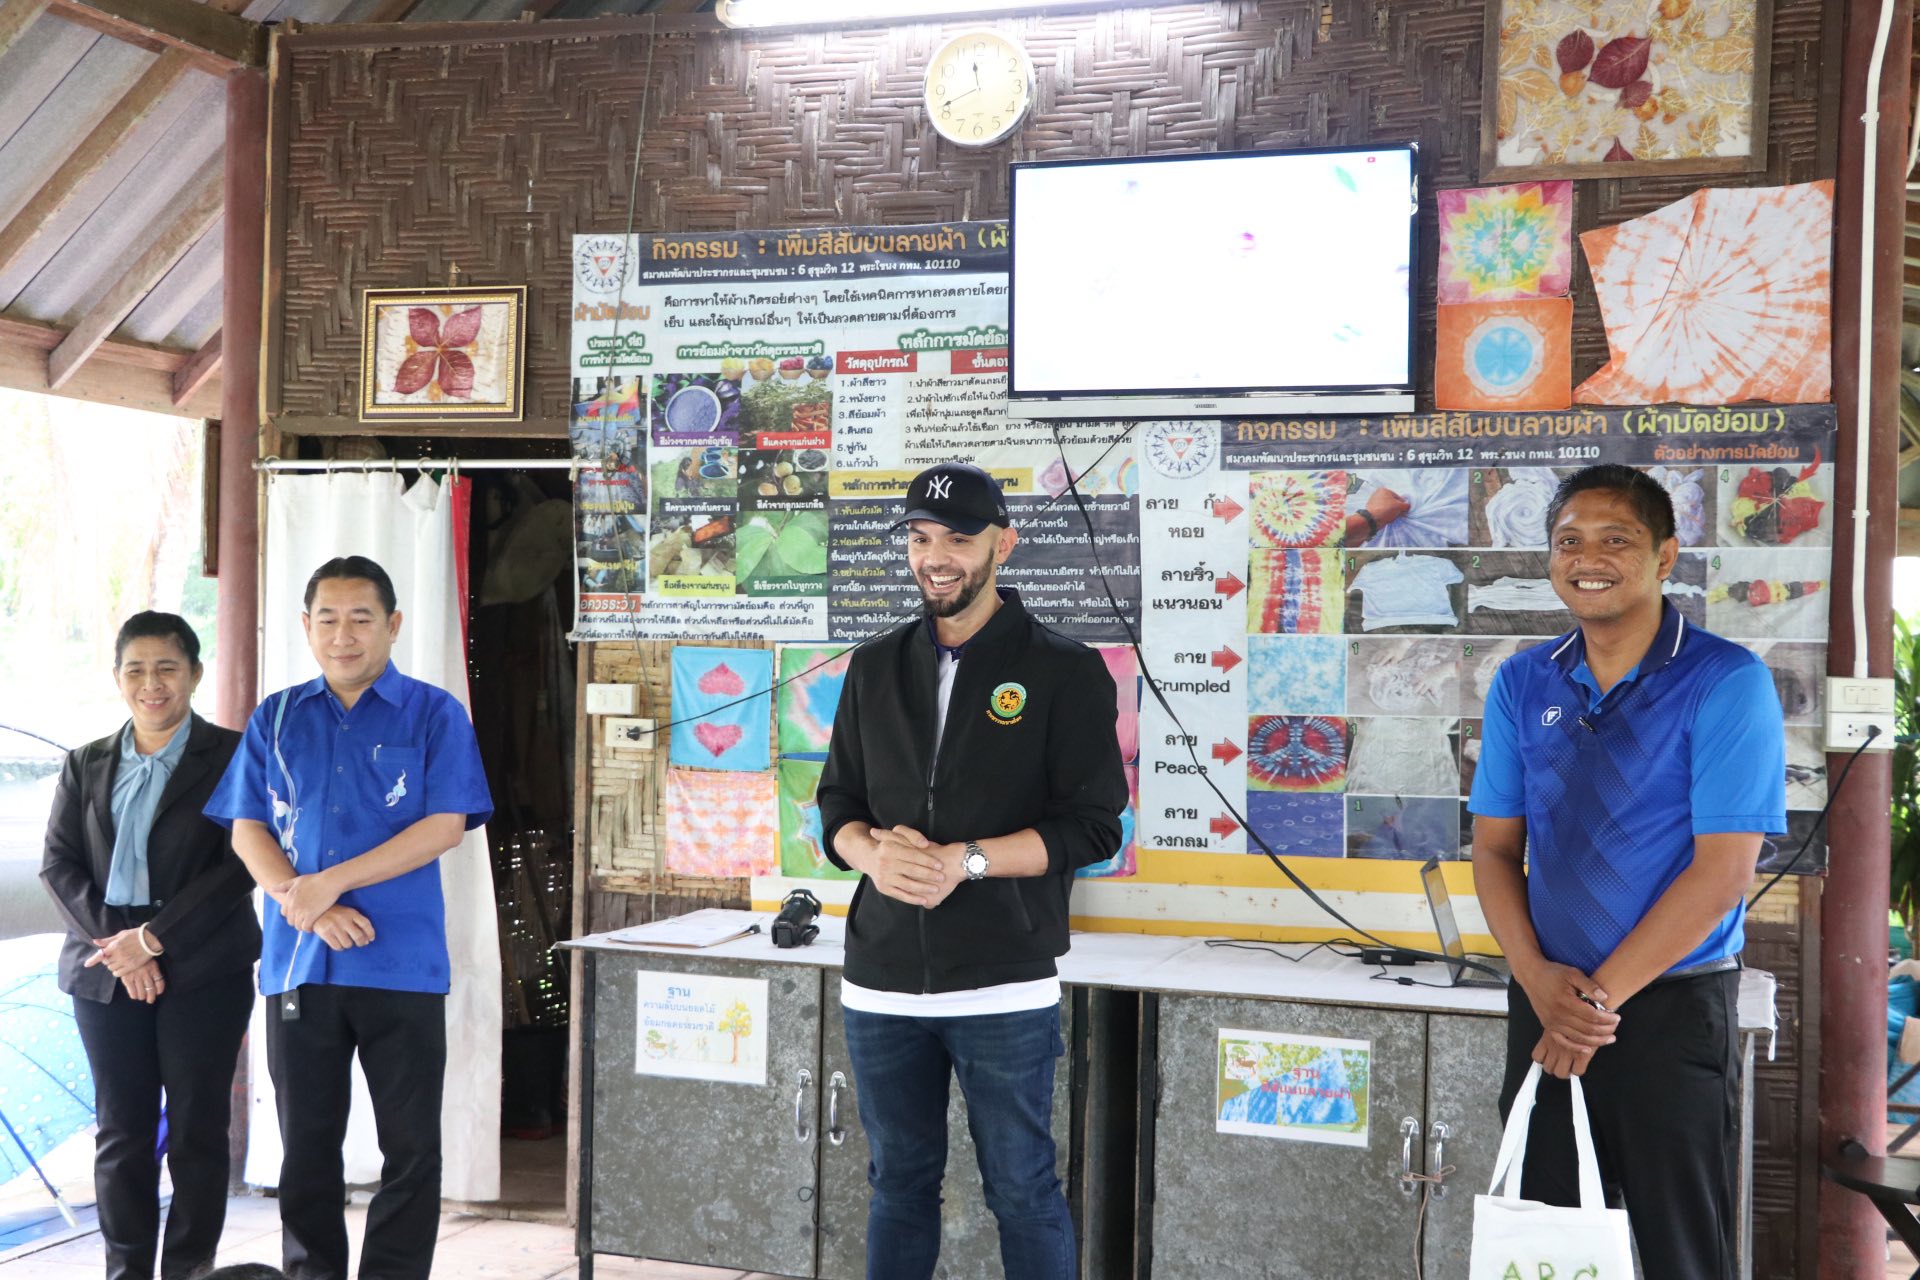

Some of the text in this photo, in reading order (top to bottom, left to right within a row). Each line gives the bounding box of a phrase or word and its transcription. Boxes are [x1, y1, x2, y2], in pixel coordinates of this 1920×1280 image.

[1008, 58, 1017, 72] 2
[941, 65, 955, 79] 10
[935, 85, 946, 99] 9
[1014, 80, 1023, 95] 3
[1005, 101, 1015, 114] 4
[955, 119, 966, 134] 7
[973, 122, 983, 137] 6
[992, 116, 1001, 130] 5
[652, 238, 738, 260] กิจกรรม
[978, 224, 1009, 249] (ผ้
[798, 264, 806, 274] 6
[841, 262, 855, 274] 12
[899, 262, 922, 271] กทม.
[925, 259, 960, 270] 10110
[900, 328, 1008, 349] หลักการมัดย้อ
[845, 354, 910, 371] วัสดุอุปกรณ์
[1406, 449, 1416, 461] 6
[1457, 448, 1474, 461] 12
[1529, 449, 1556, 460] กทม.
[1558, 446, 1600, 459] 10110
[1350, 473, 1357, 485] 1
[1474, 471, 1482, 484] 2
[1721, 469, 1730, 483] 4
[1145, 497, 1179, 510] ลาย
[1168, 526, 1205, 538] หอย
[1348, 558, 1356, 570] 1
[1472, 555, 1480, 568] 2
[1711, 555, 1721, 571] 4
[1161, 561, 1215, 582] ลายริ้ว
[1152, 598, 1223, 610] แนวนอน
[1351, 642, 1359, 655] 1
[1464, 643, 1473, 656] 2
[1174, 652, 1206, 664] ลาย
[1150, 679, 1231, 695] Crumpled
[1350, 722, 1357, 735] 1
[1465, 725, 1473, 737] 2
[1165, 734, 1197, 746] ลาย
[1155, 761, 1208, 775] Peace
[1355, 800, 1361, 811] 1
[1164, 807, 1198, 819] ลาย
[1153, 835, 1208, 848] วงกลม
[667, 986, 691, 999] ฐาน
[1293, 1067, 1321, 1080] ฐาน
